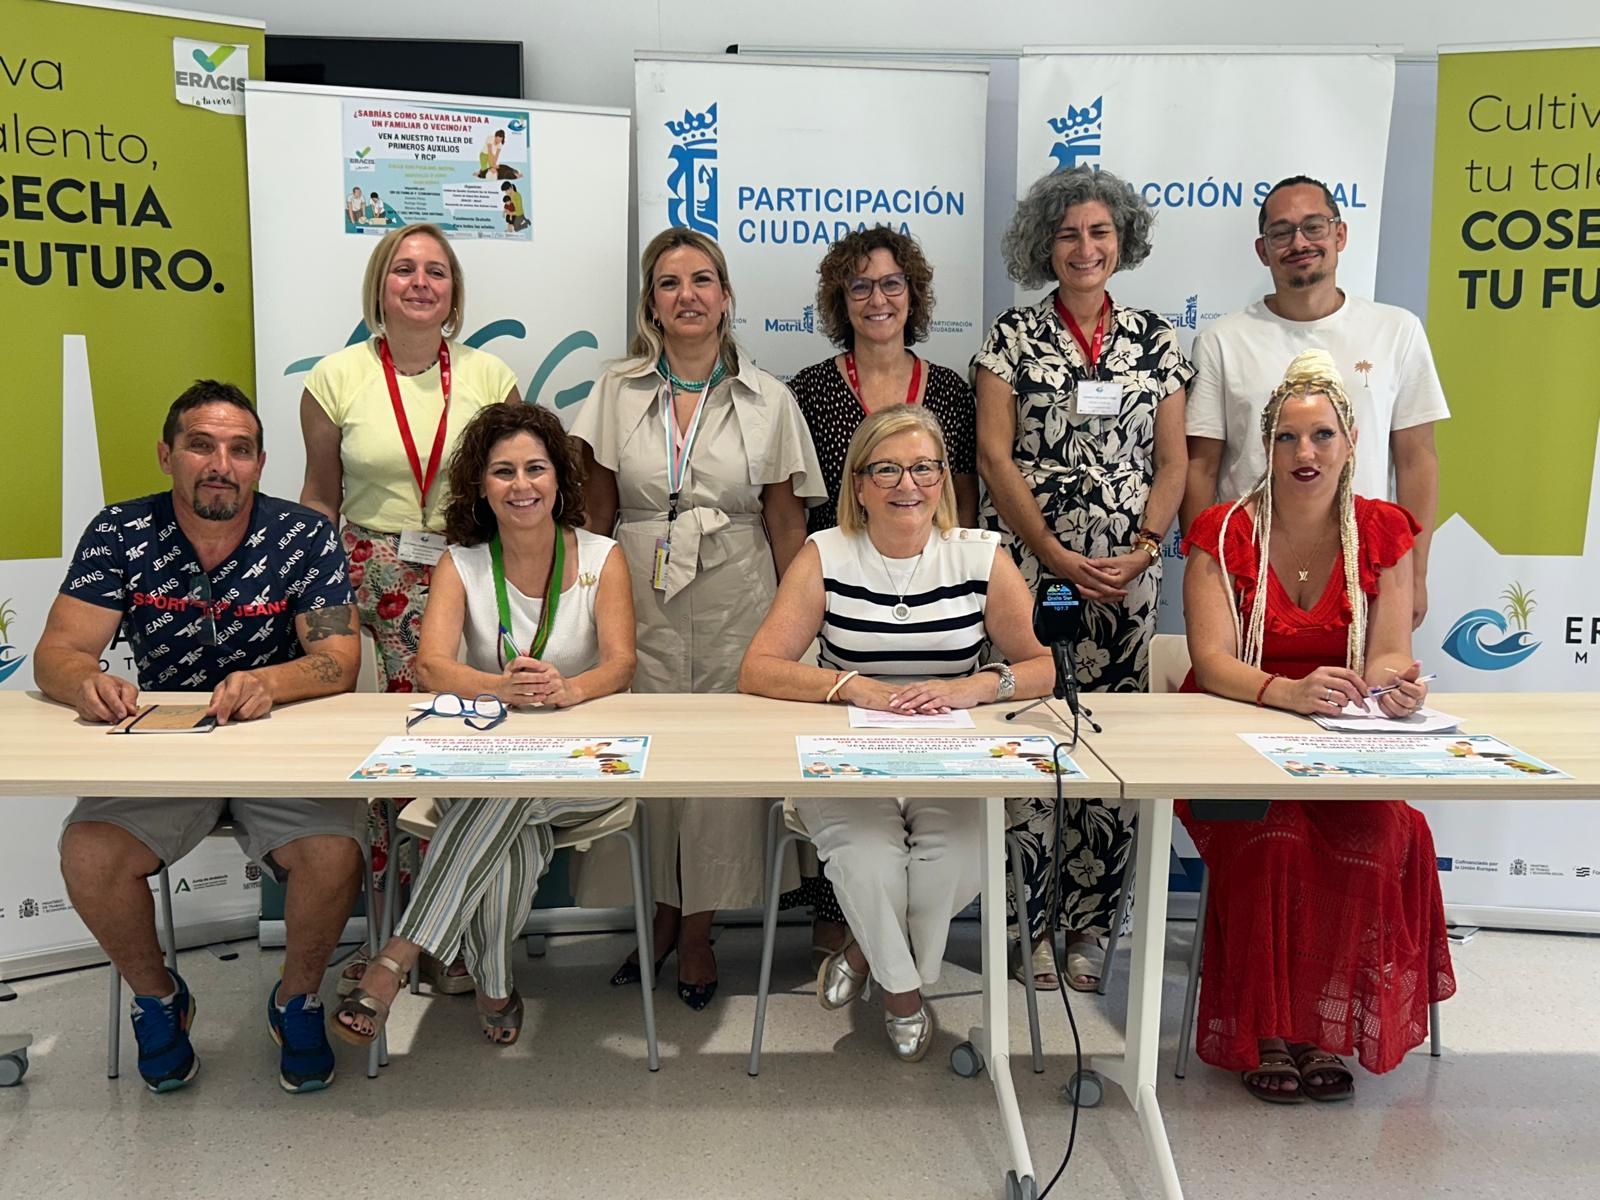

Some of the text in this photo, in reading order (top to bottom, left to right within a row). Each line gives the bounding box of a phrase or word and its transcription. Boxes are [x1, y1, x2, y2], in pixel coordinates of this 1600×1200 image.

[176, 71, 246, 92] ERACIS
[384, 121, 421, 129] FAMILIAR
[394, 111, 417, 120] COMO
[419, 113, 450, 121] SALVAR
[0, 112, 158, 170] lento,
[388, 143, 460, 153] PRIMEROS AUXILIOS
[401, 134, 434, 142] NUESTRO
[421, 153, 436, 161] RCP
[1465, 153, 1600, 193] tu tal
[738, 185, 965, 216] PARTICIPACIÓN
[1458, 268, 1524, 310] TU
[277, 521, 306, 550] JEANS
[81, 545, 112, 561] JEANS
[152, 545, 182, 571] JEANS
[278, 549, 305, 579] JEANS
[69, 570, 105, 590] JEANS
[216, 620, 243, 645] JEANS
